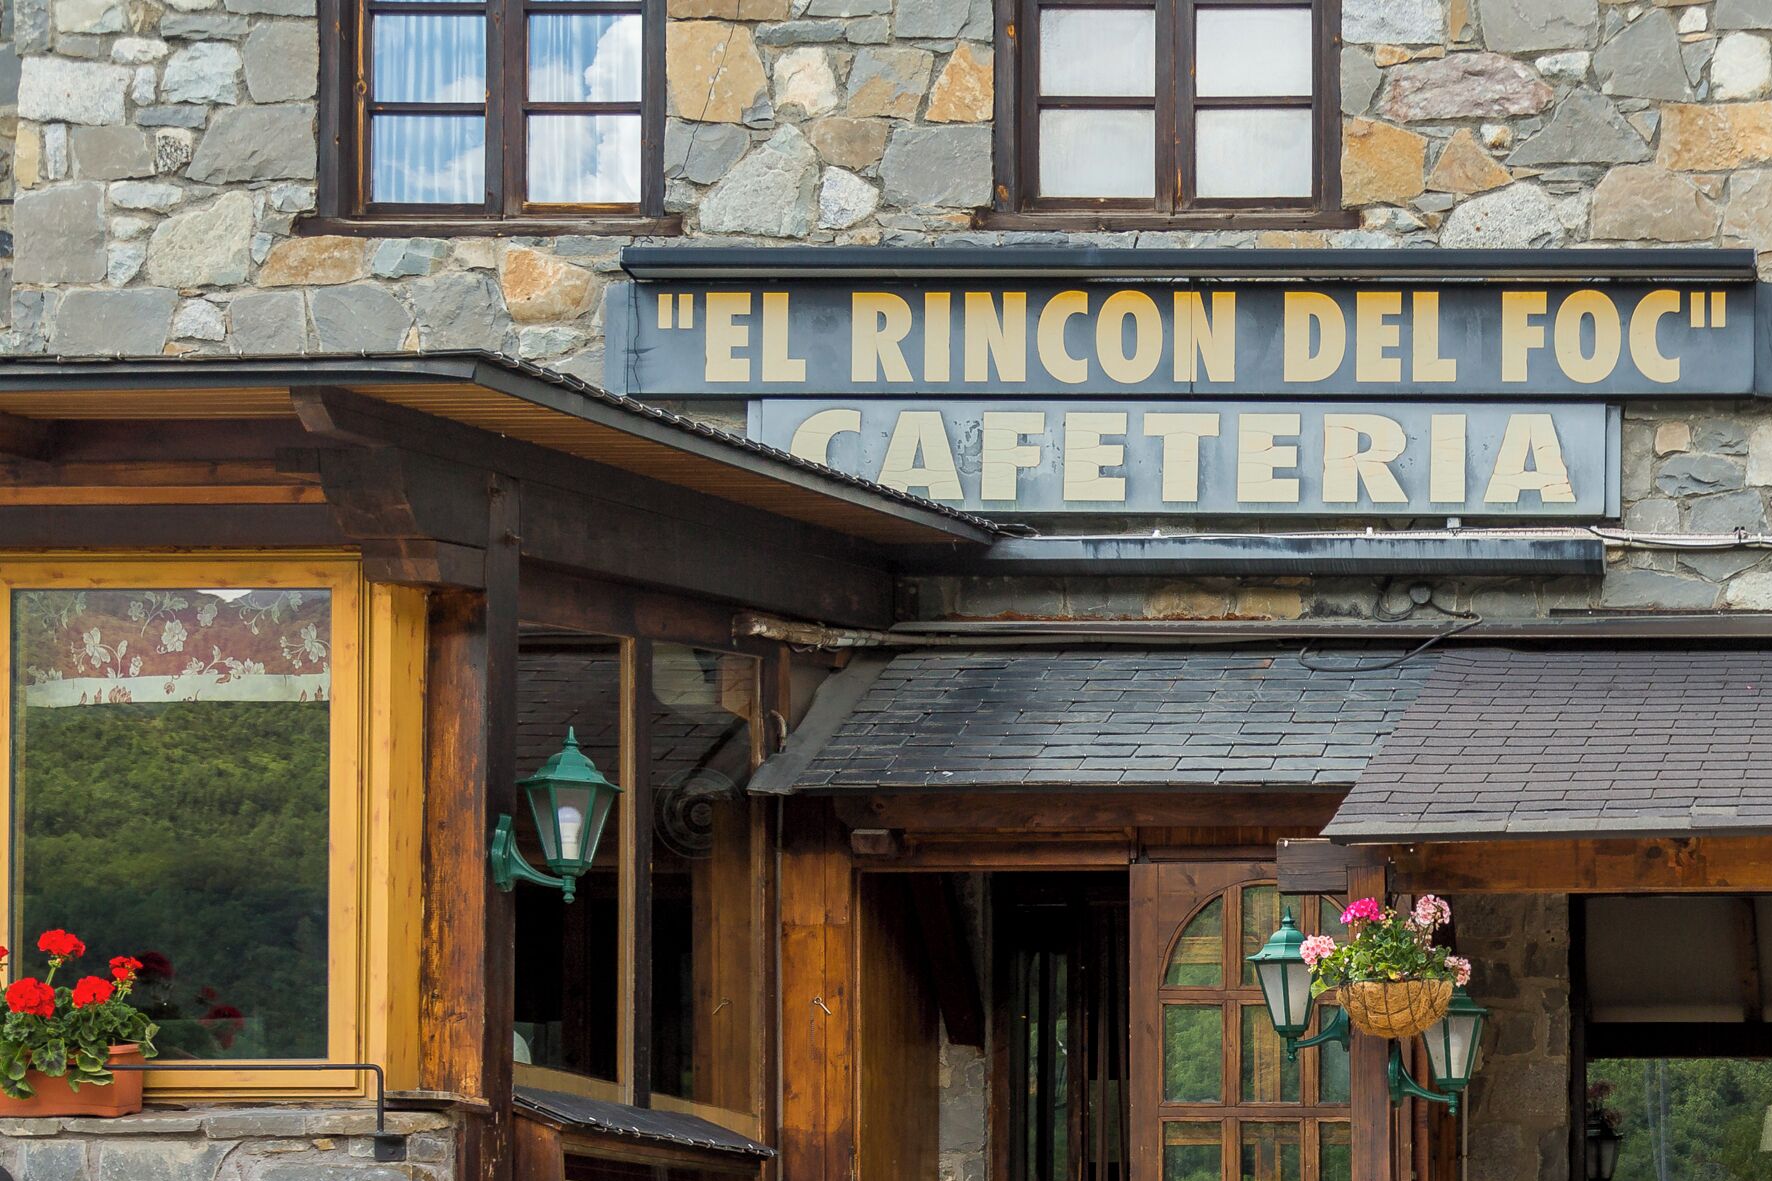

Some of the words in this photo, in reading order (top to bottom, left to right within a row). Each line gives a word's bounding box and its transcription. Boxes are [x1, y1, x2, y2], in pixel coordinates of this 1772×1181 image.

[850, 288, 1236, 384] RINCON
[1282, 290, 1457, 384] DEL
[789, 408, 1577, 503] CAFETERIA
